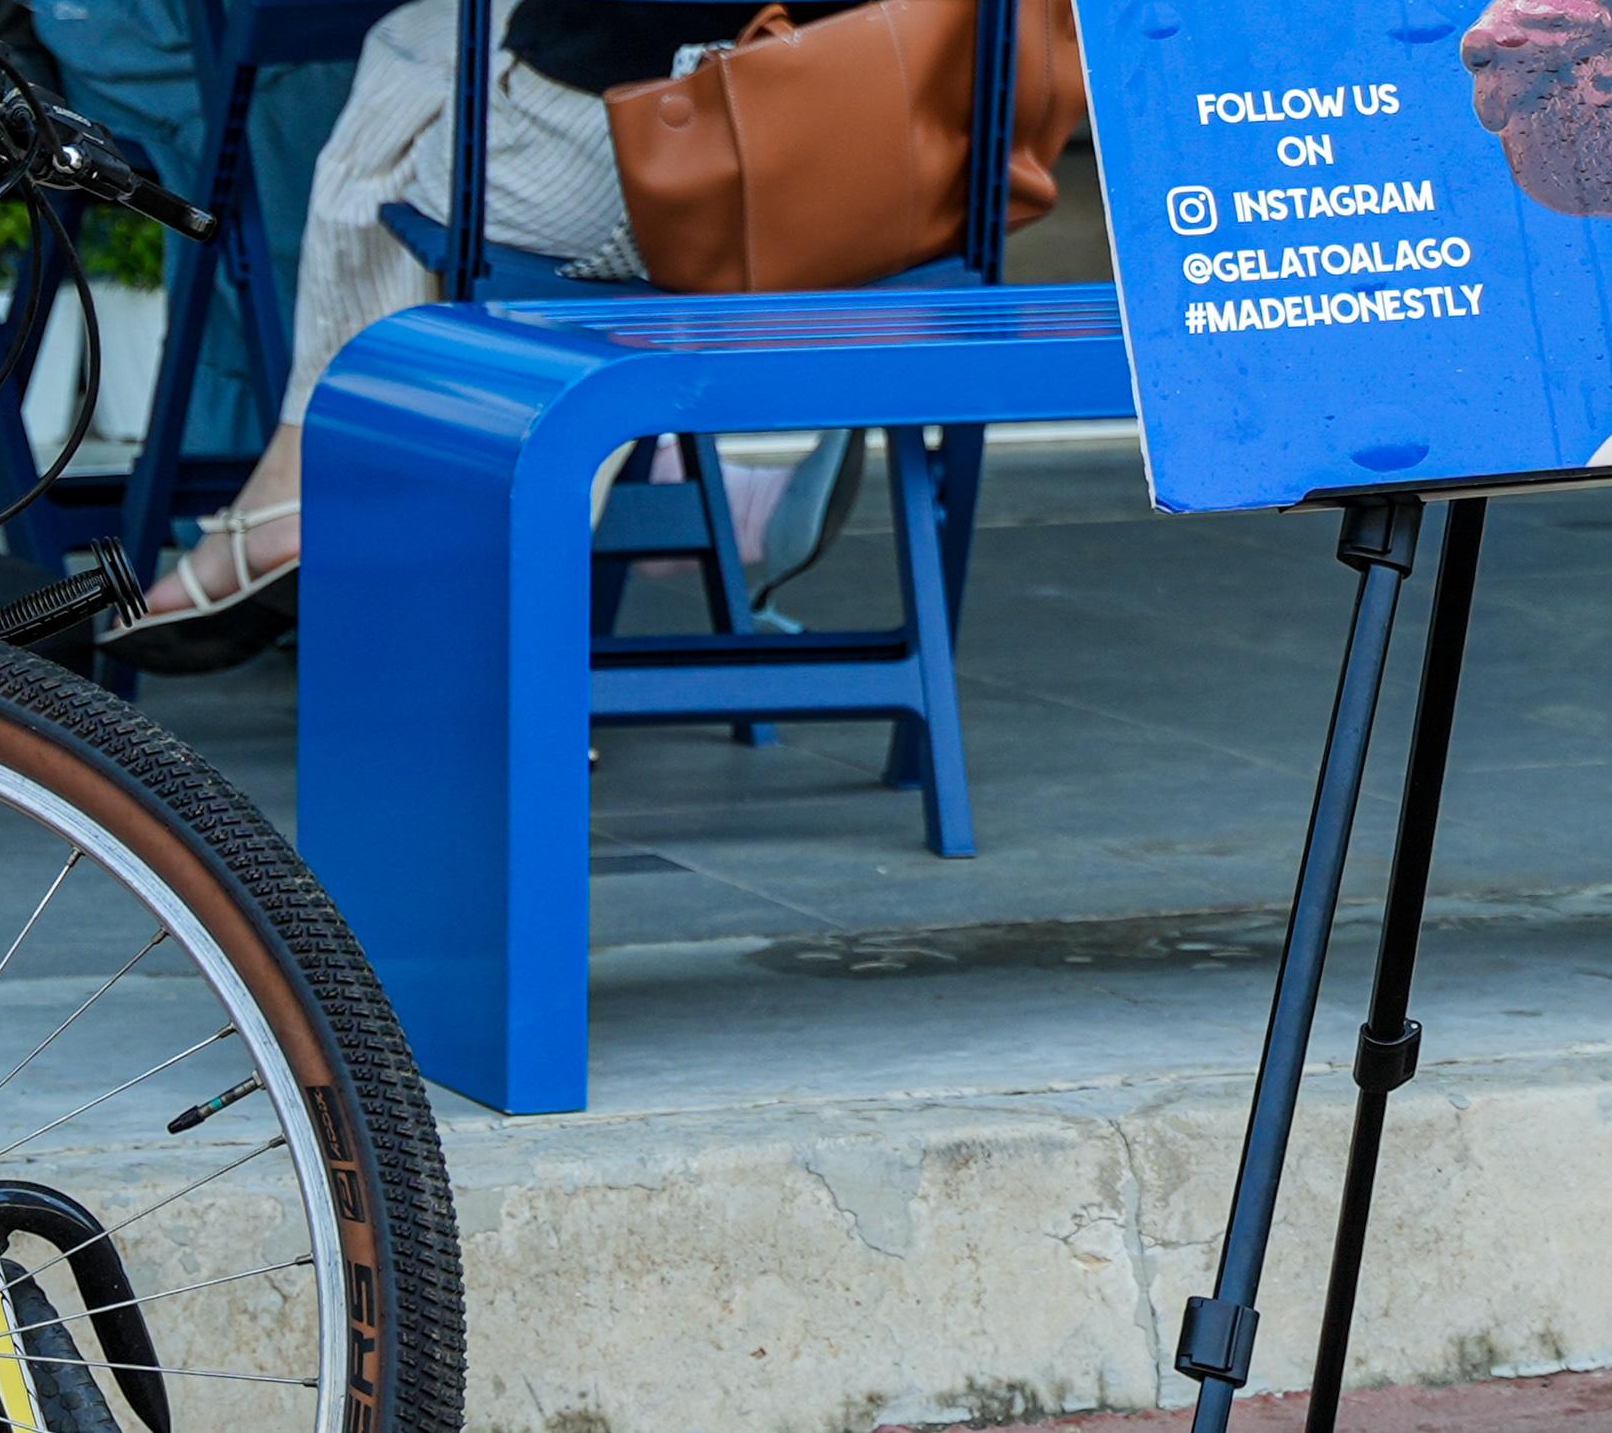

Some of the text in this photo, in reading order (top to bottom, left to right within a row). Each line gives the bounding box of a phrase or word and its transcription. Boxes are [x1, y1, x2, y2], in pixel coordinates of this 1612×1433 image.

[1196, 83, 1400, 125] FOLLOW US
[1276, 134, 1335, 167] ON
[1233, 180, 1436, 223] INSTAGRAM
[1182, 236, 1471, 284] @GELATOALAGO
[1184, 283, 1484, 334] #MADEHONESTLY
